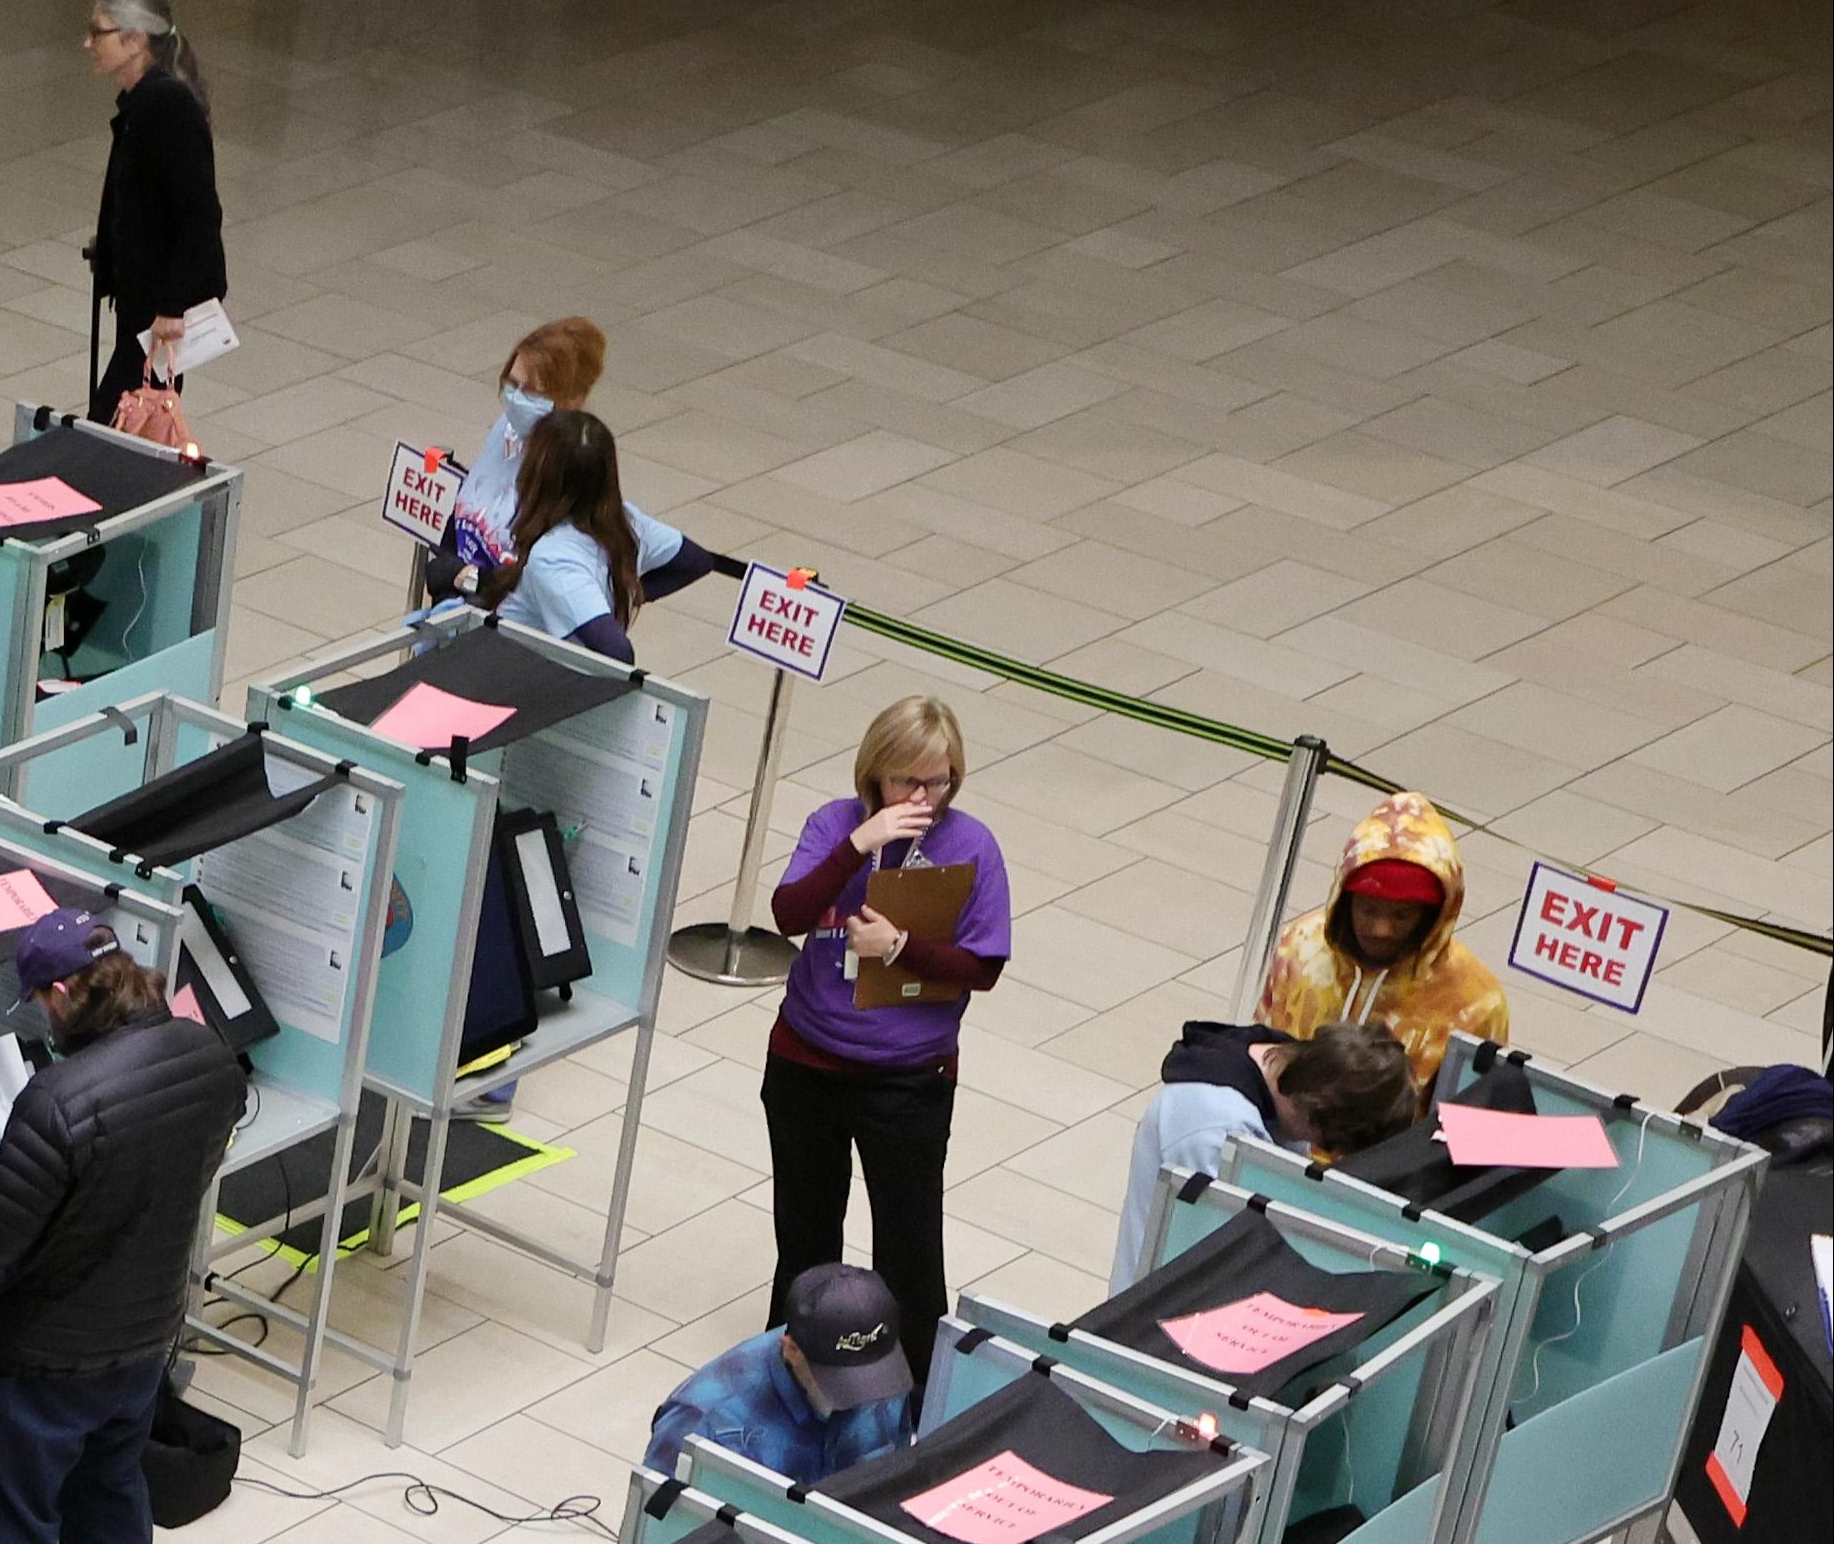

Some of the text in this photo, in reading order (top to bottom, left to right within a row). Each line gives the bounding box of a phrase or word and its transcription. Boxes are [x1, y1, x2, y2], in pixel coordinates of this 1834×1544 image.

[402, 467, 446, 503] EXIT
[395, 490, 444, 531] HERE
[759, 590, 819, 628] EXIT
[747, 613, 816, 657] HERE
[1540, 889, 1645, 951] EXIT
[1534, 932, 1626, 987] HERE
